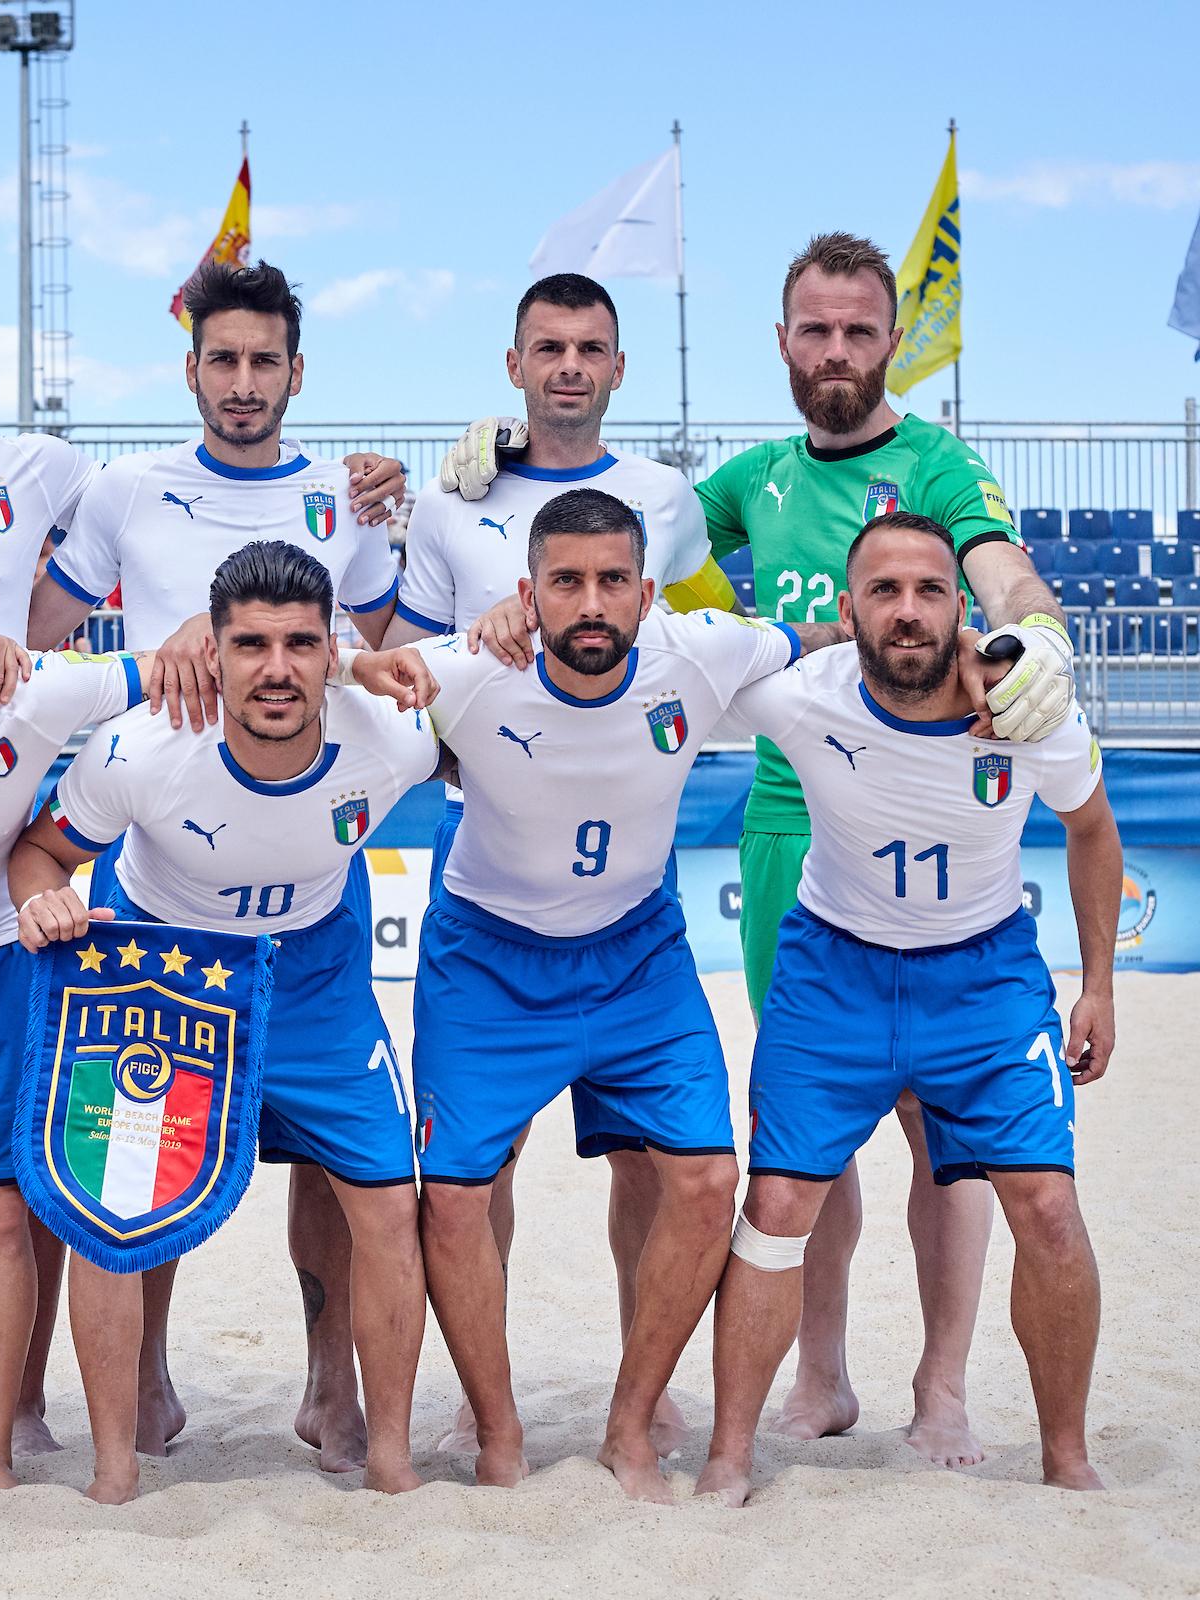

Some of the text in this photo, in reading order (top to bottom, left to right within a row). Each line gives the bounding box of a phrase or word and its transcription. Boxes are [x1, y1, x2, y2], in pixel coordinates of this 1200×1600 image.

[870, 486, 897, 495] ITALIA
[306, 495, 334, 505] ITALIA
[649, 703, 680, 722] ITALIA
[976, 757, 1009, 768] ITALIA
[335, 801, 365, 818] ITALIA
[572, 819, 612, 878] 9
[872, 839, 949, 901] 11
[218, 883, 295, 918] 10
[78, 1005, 216, 1054] ITALIA
[129, 1061, 160, 1077] FIGC
[84, 1104, 193, 1126] WORLD BEACH GAME
[97, 1118, 176, 1136] EUROPE QUALIFIER
[137, 1136, 157, 1149] May
[159, 1140, 182, 1150] 2019
